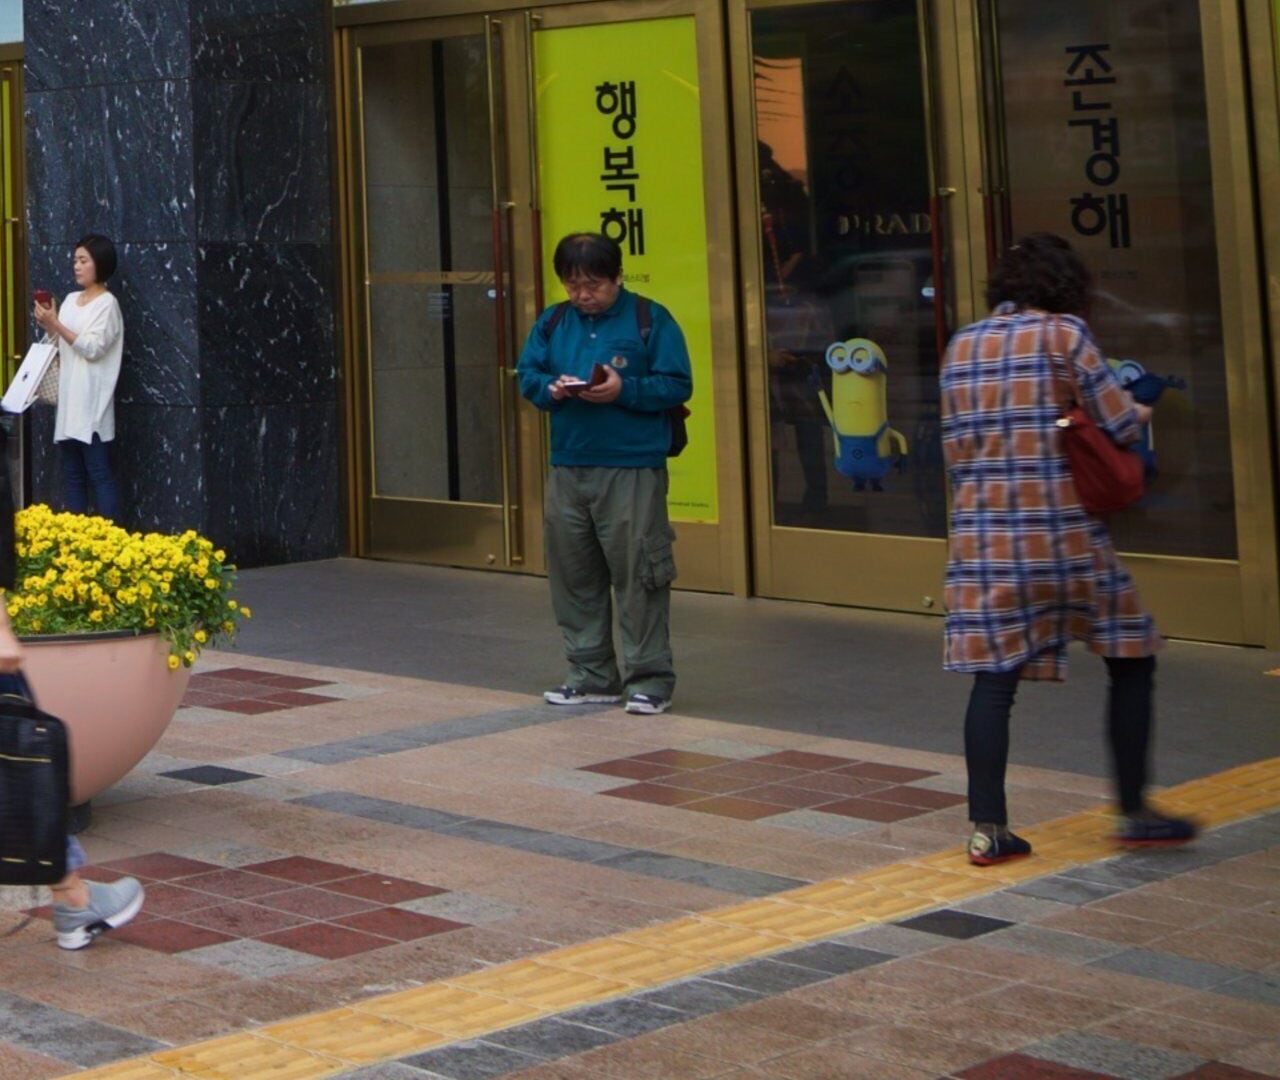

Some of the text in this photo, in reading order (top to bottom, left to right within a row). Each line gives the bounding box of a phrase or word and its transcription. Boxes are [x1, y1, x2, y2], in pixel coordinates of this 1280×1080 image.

[594, 81, 647, 256] 행복해
[836, 213, 932, 235] PRAD
[1063, 43, 1132, 250] 존경해
